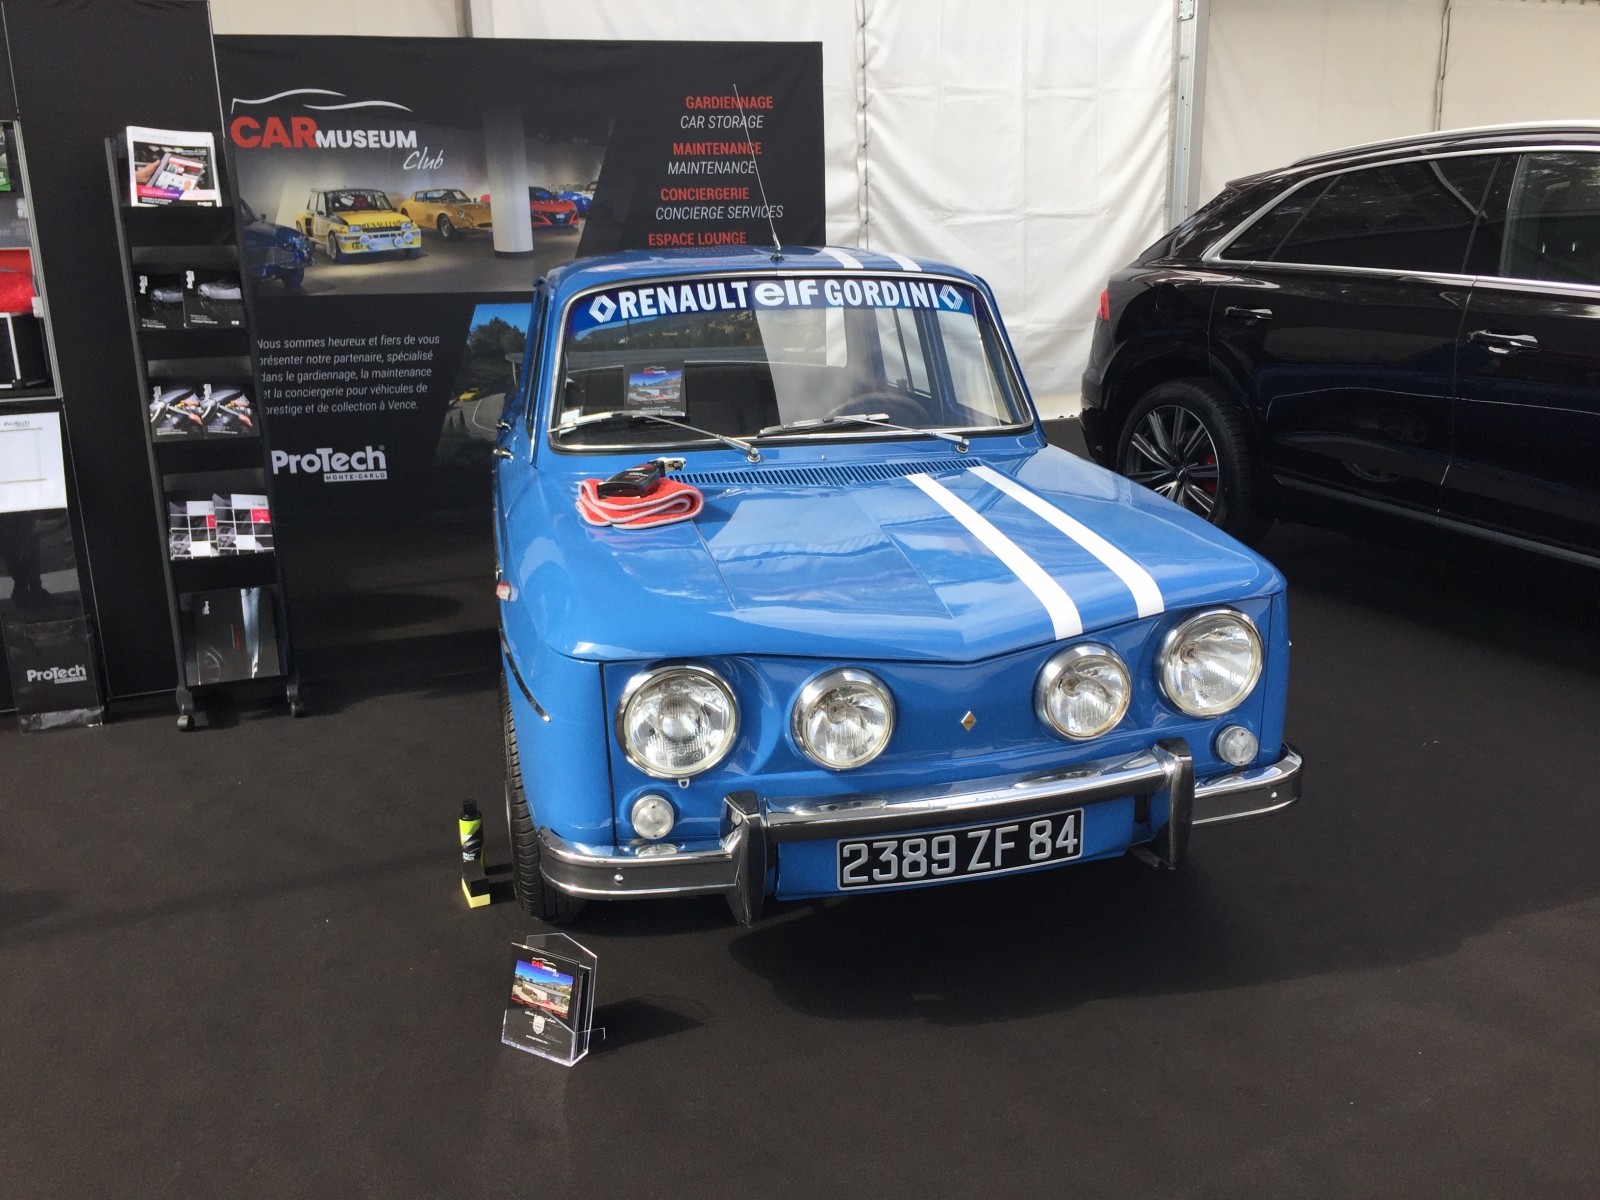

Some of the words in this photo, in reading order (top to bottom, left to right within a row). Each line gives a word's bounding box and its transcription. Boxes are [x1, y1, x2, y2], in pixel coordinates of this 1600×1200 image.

[685, 96, 773, 109] GARDIENNAGE
[680, 115, 705, 129] CAR
[708, 115, 764, 129] STORAGE
[673, 142, 762, 155] MAINTENANCE
[402, 146, 444, 170] Club
[667, 161, 755, 174] MAINTENANCE
[660, 187, 750, 201] CONCIERGERIE
[655, 206, 724, 220] CONCIERGE
[727, 205, 784, 219] SERVICES
[648, 232, 695, 246] ESPACE
[698, 231, 747, 245] LOUNGE
[619, 281, 749, 319] RENAULT
[753, 278, 819, 307] elf
[824, 279, 940, 309] GORDINI
[283, 337, 326, 349] sommes
[328, 336, 366, 348] heureux
[368, 336, 378, 346] et
[380, 334, 401, 346] fiers
[404, 333, 415, 345] de
[418, 335, 440, 345] vous
[306, 354, 331, 365] notre
[333, 352, 385, 367] partenaire,
[386, 350, 434, 364] spécialisé
[286, 371, 295, 382] le
[297, 369, 358, 384] gardiennage,
[361, 368, 369, 379] la
[371, 367, 432, 379] maintenance
[274, 387, 282, 399] la
[285, 385, 344, 399] conciergerie
[346, 385, 368, 398] pour
[370, 383, 414, 396] véhicules
[416, 382, 428, 394] de
[305, 402, 315, 414] et
[317, 401, 329, 413] de
[331, 400, 377, 413] collection
[380, 399, 386, 411] à
[387, 400, 419, 411] Vence.
[271, 445, 387, 474] ProTech
[325, 471, 386, 481] MONTE-CARLO
[26, 664, 87, 682] ProTech
[843, 834, 957, 884] 2389
[967, 825, 1019, 871] ZF
[1029, 815, 1078, 861] 84
